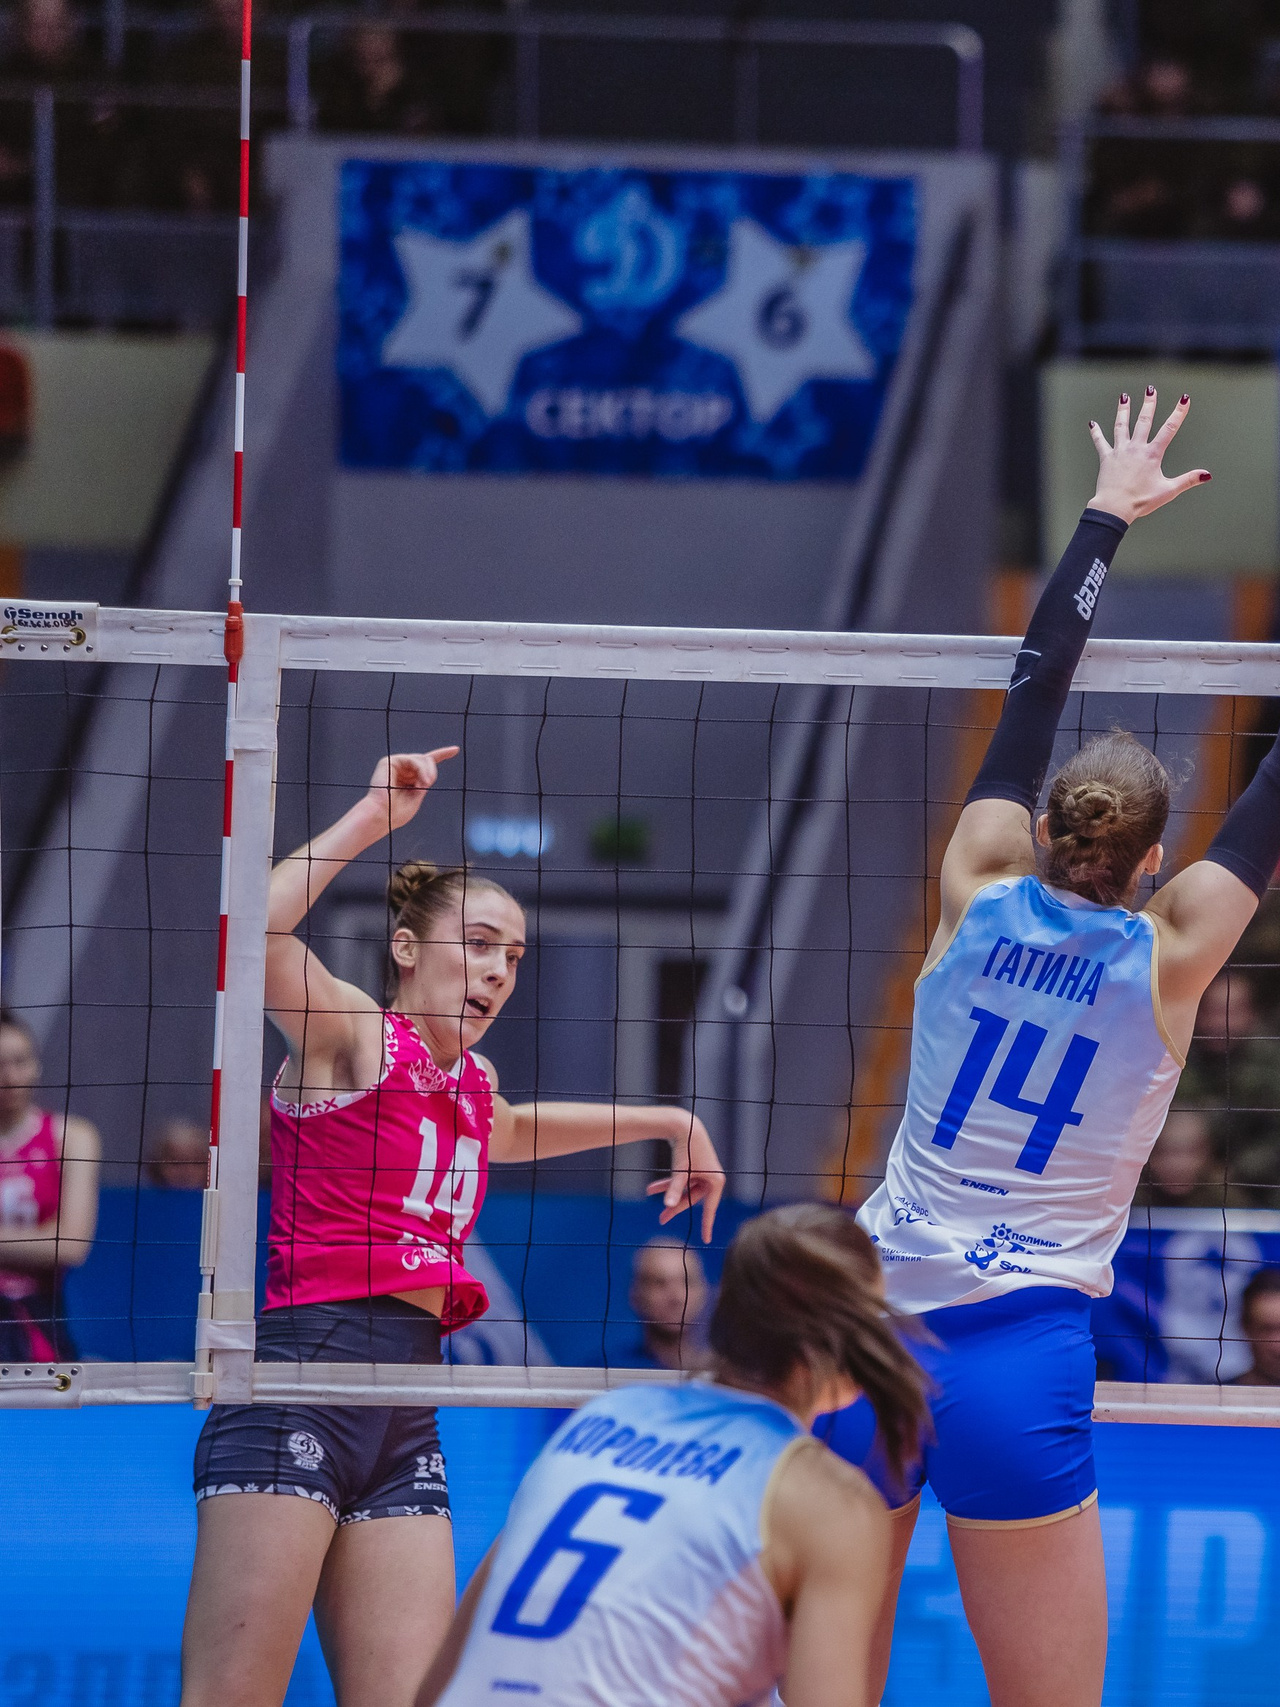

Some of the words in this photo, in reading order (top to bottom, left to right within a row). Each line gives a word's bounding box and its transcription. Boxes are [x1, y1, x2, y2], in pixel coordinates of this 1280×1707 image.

[451, 265, 496, 342] 7
[758, 286, 807, 349] 6
[528, 388, 732, 440] СЕКТОР
[18, 608, 83, 620] Senoh
[982, 936, 1106, 1006] ГАТИНА
[931, 1006, 1100, 1175] 14
[401, 1116, 482, 1240] 14
[960, 1178, 1010, 1196] ENSEN
[490, 1481, 667, 1642] 6
